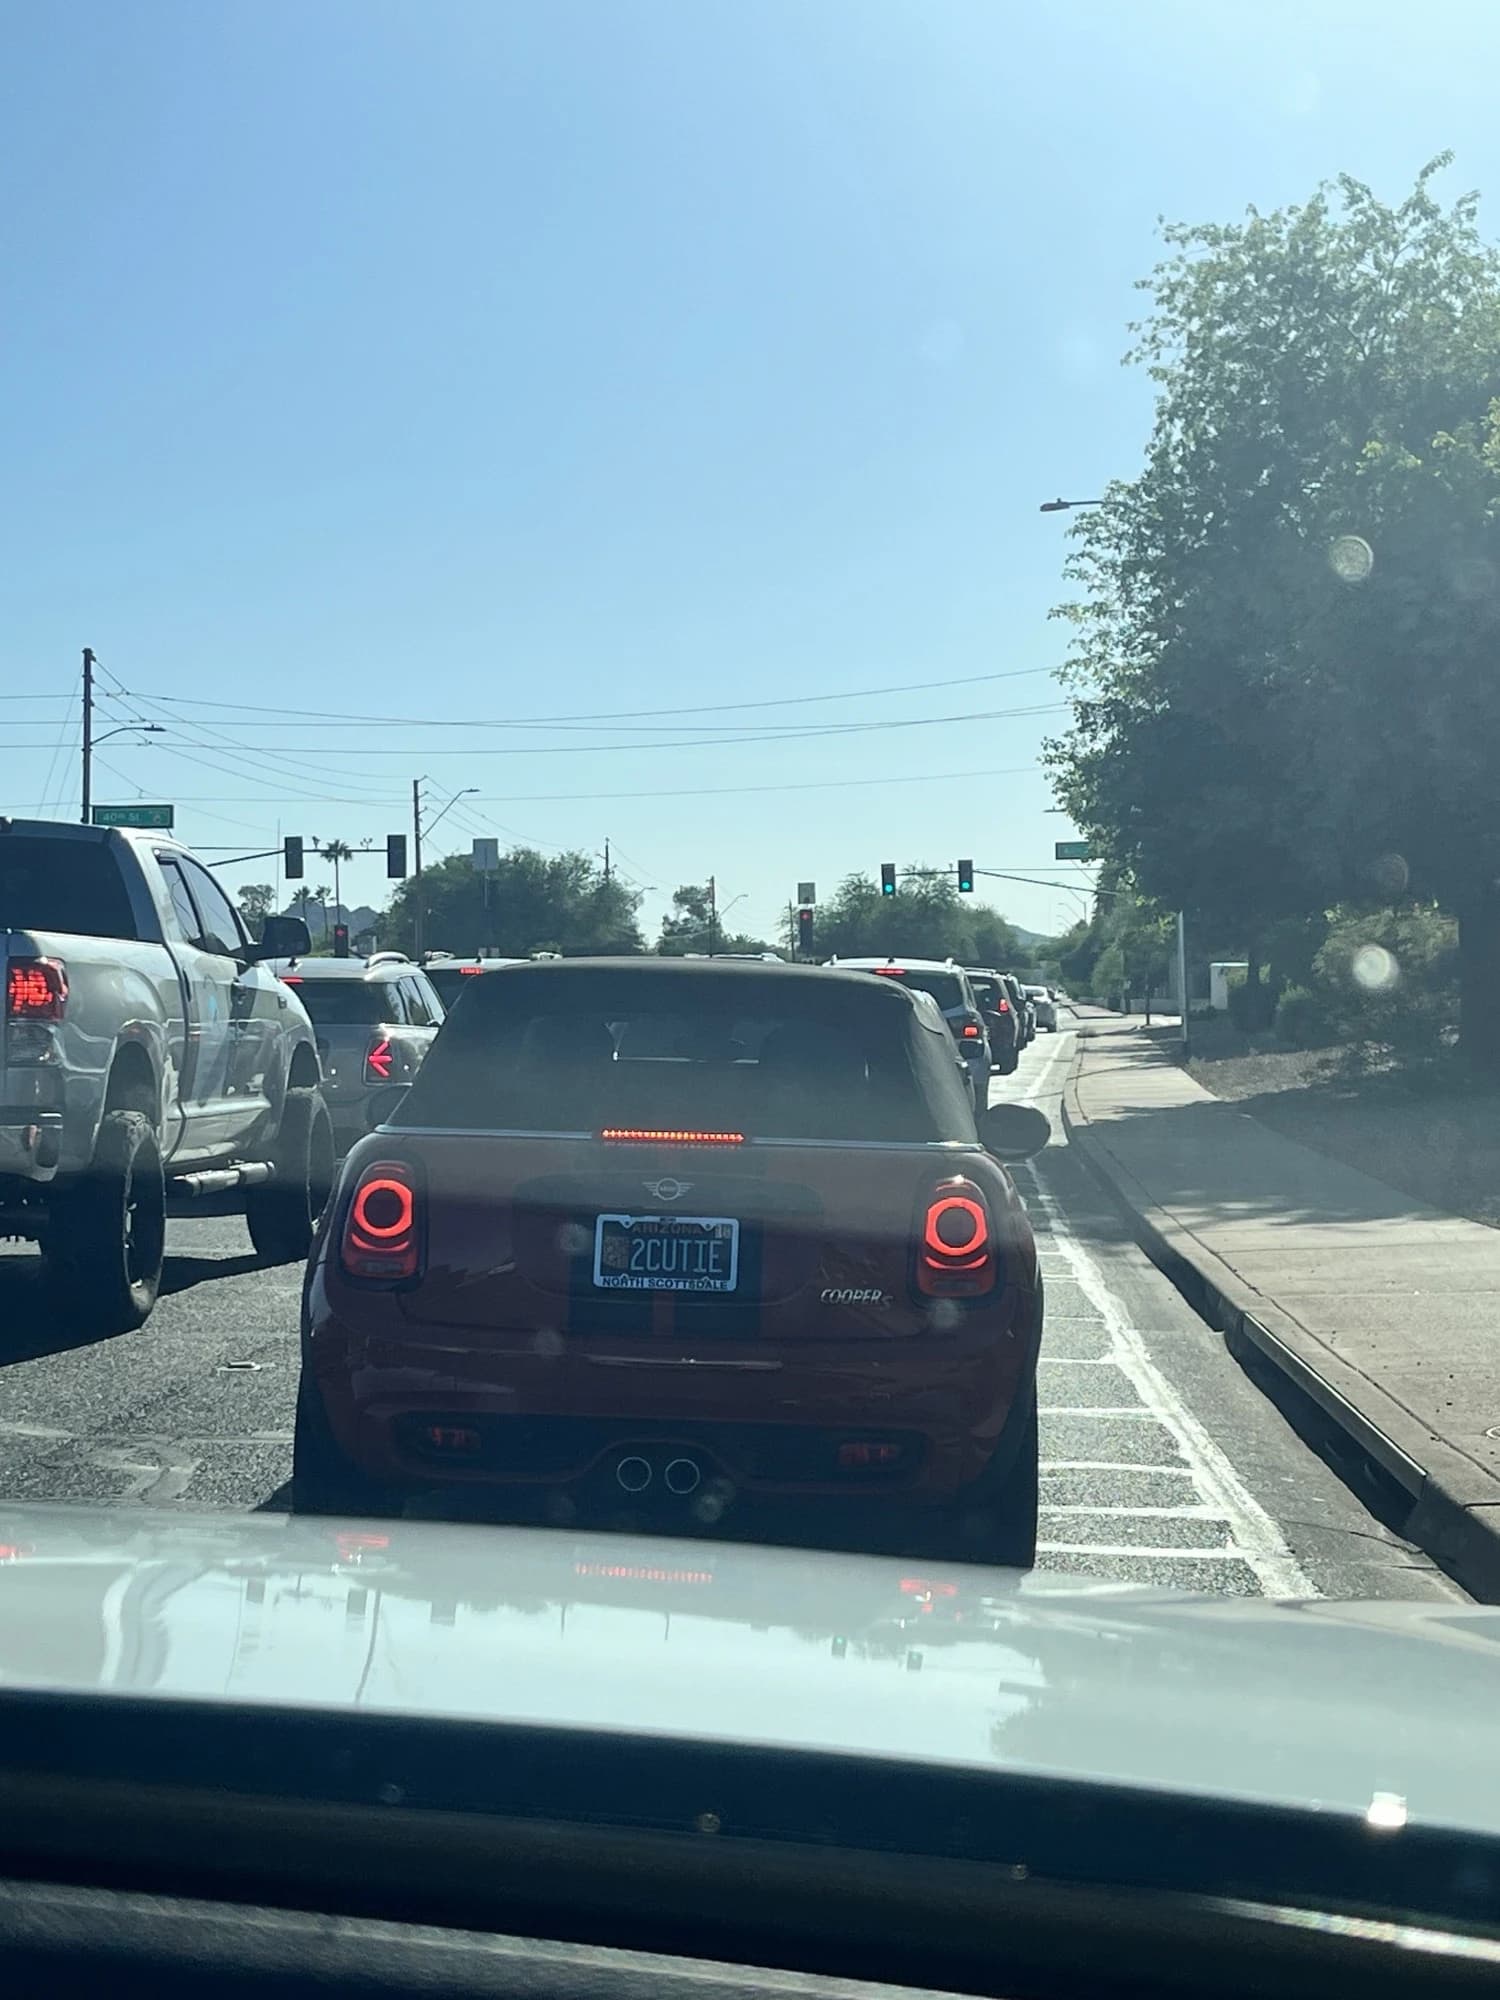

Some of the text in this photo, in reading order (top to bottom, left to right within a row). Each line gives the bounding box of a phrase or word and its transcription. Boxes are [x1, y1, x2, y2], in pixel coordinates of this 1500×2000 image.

[632, 1223, 704, 1234] ARIZONA
[631, 1238, 723, 1273] 2CUTIE
[602, 1276, 728, 1290] NORTH SCOTTSDALE
[820, 1288, 882, 1305] COOPER
